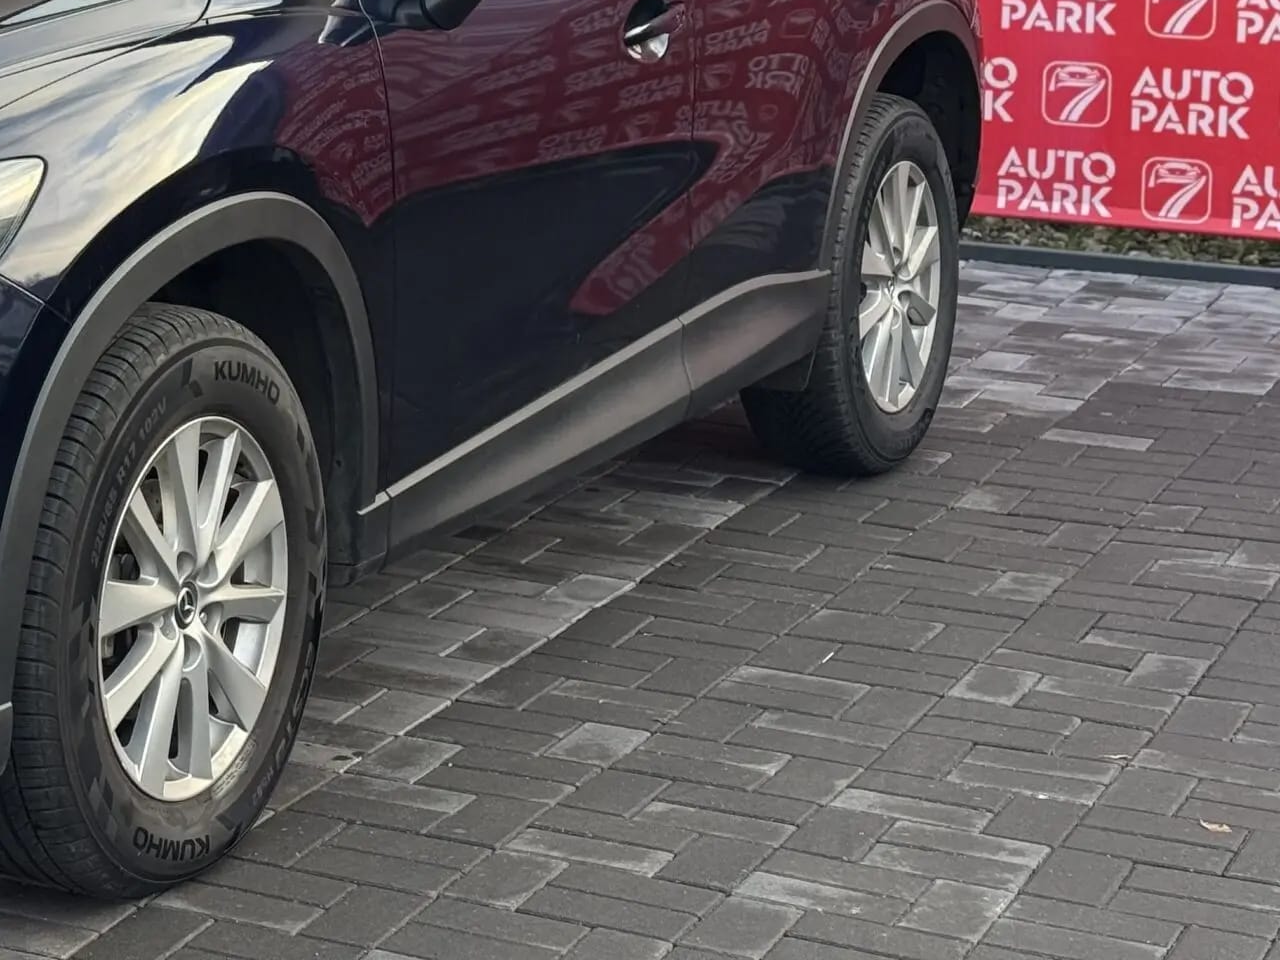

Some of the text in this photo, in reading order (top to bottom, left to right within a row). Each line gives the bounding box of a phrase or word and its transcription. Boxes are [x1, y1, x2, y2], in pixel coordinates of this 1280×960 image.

[1131, 67, 1254, 104] AUTO
[1131, 100, 1249, 139] PARK
[998, 147, 1115, 184] AUTO
[997, 180, 1112, 217] PARK
[213, 359, 281, 407] KUMHO
[135, 825, 211, 863] KUMHO
